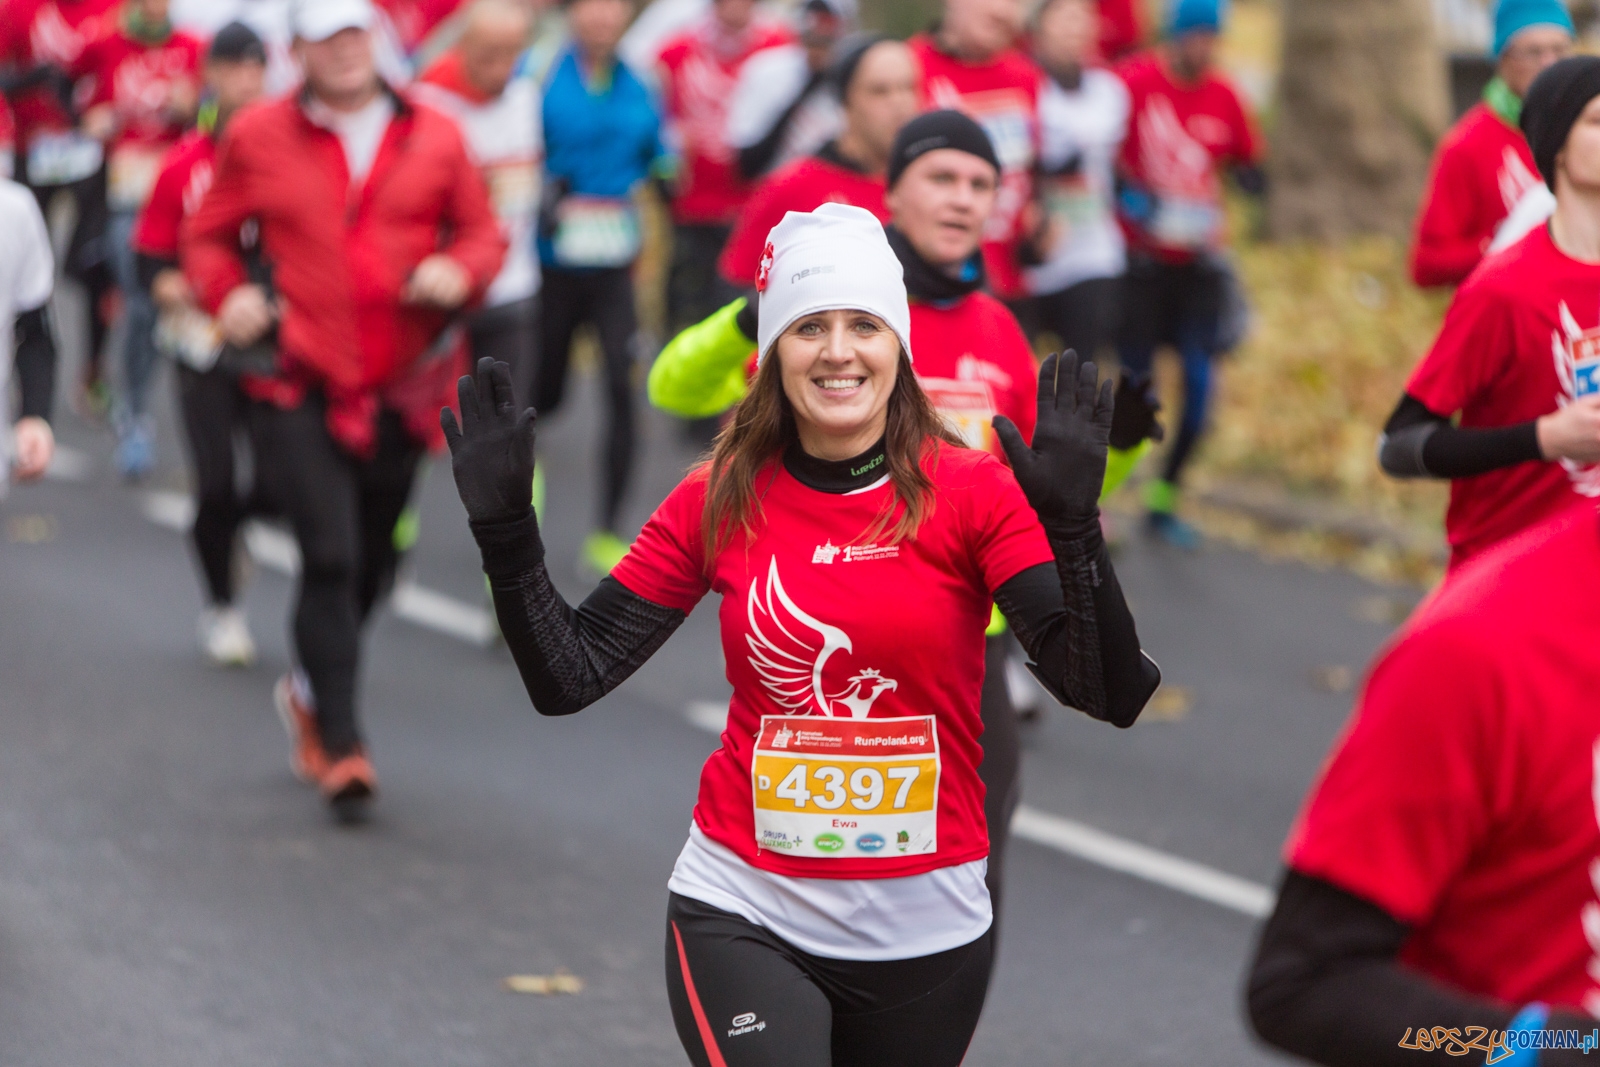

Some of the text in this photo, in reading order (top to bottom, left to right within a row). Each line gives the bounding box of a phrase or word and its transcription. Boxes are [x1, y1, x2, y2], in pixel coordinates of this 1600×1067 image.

[854, 735, 925, 746] RunPoland.org
[758, 764, 920, 810] D 4397
[832, 819, 858, 828] Ewa
